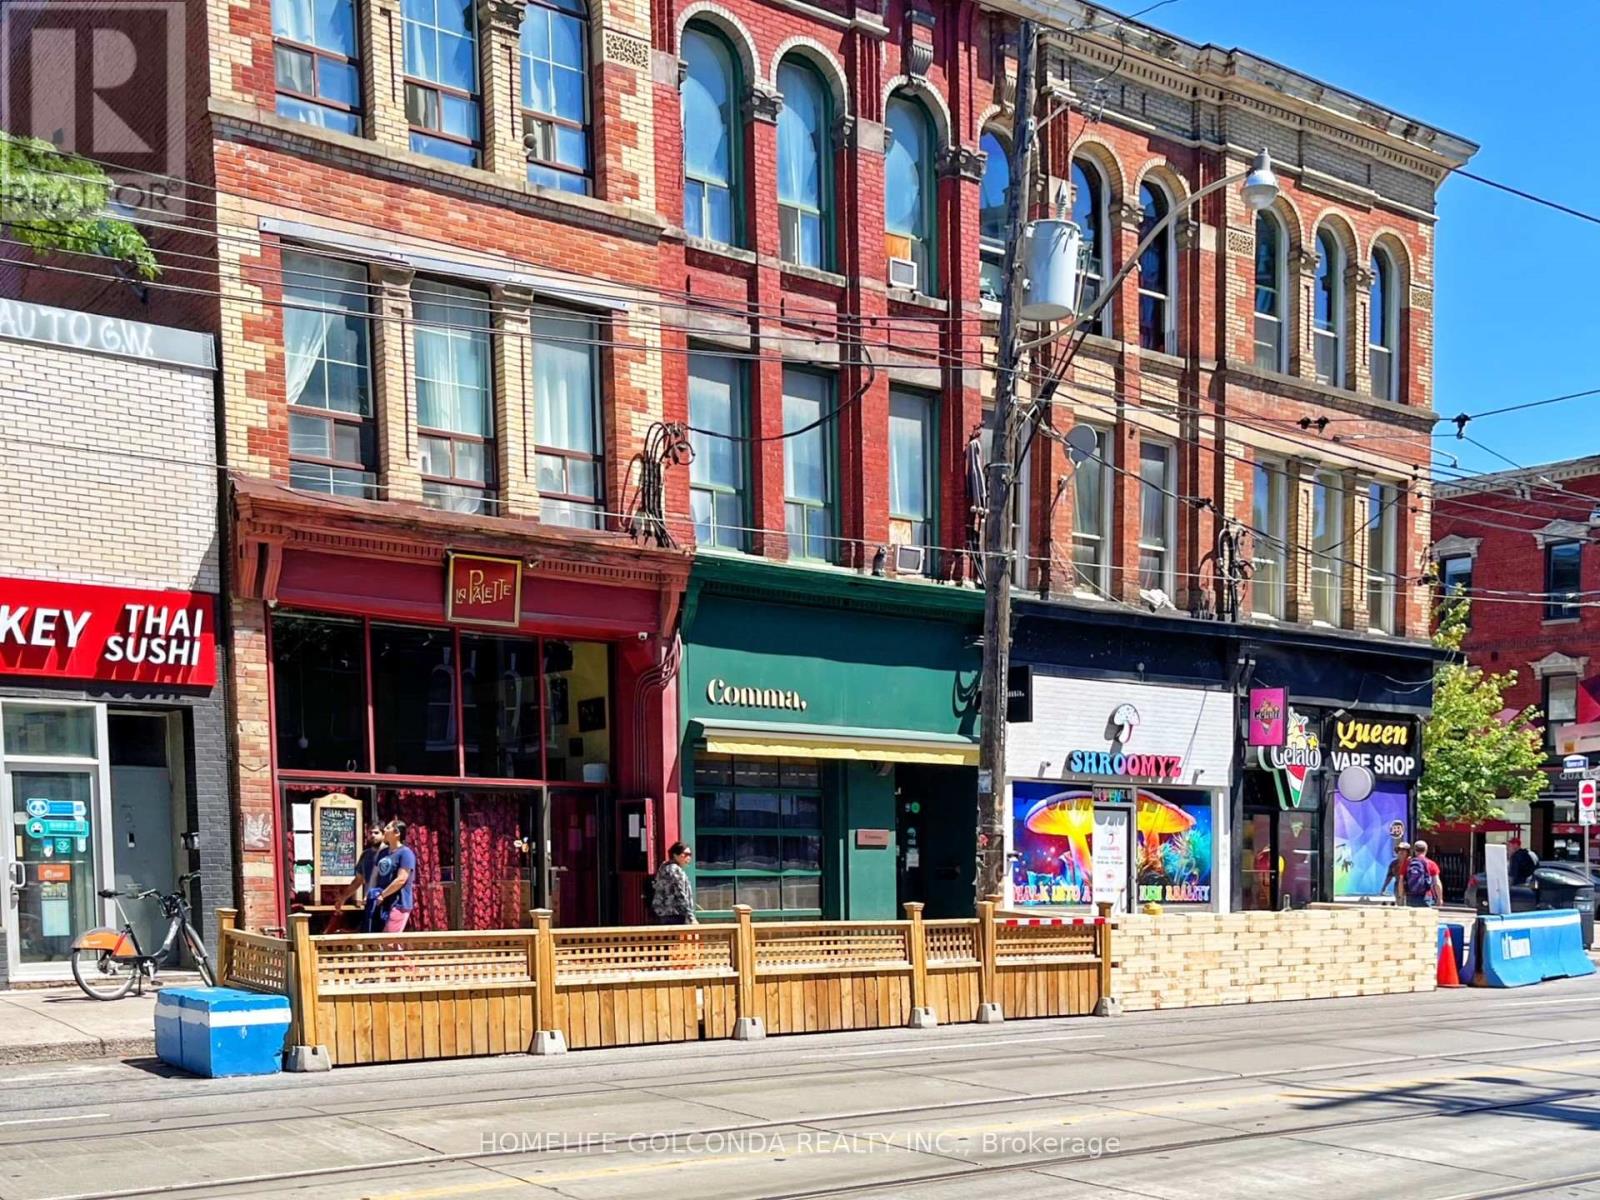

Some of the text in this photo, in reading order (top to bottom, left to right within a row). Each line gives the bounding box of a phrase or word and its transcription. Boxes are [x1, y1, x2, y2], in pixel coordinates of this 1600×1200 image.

[0, 304, 92, 347] AUTO
[469, 569, 512, 605] PALETTE
[0, 604, 92, 648] KEY
[125, 604, 203, 637] THAI
[104, 636, 201, 666] SUSHI
[1337, 720, 1408, 749] Queen
[1070, 751, 1182, 777] SHROOMYZ
[1374, 754, 1415, 776] SHOP
